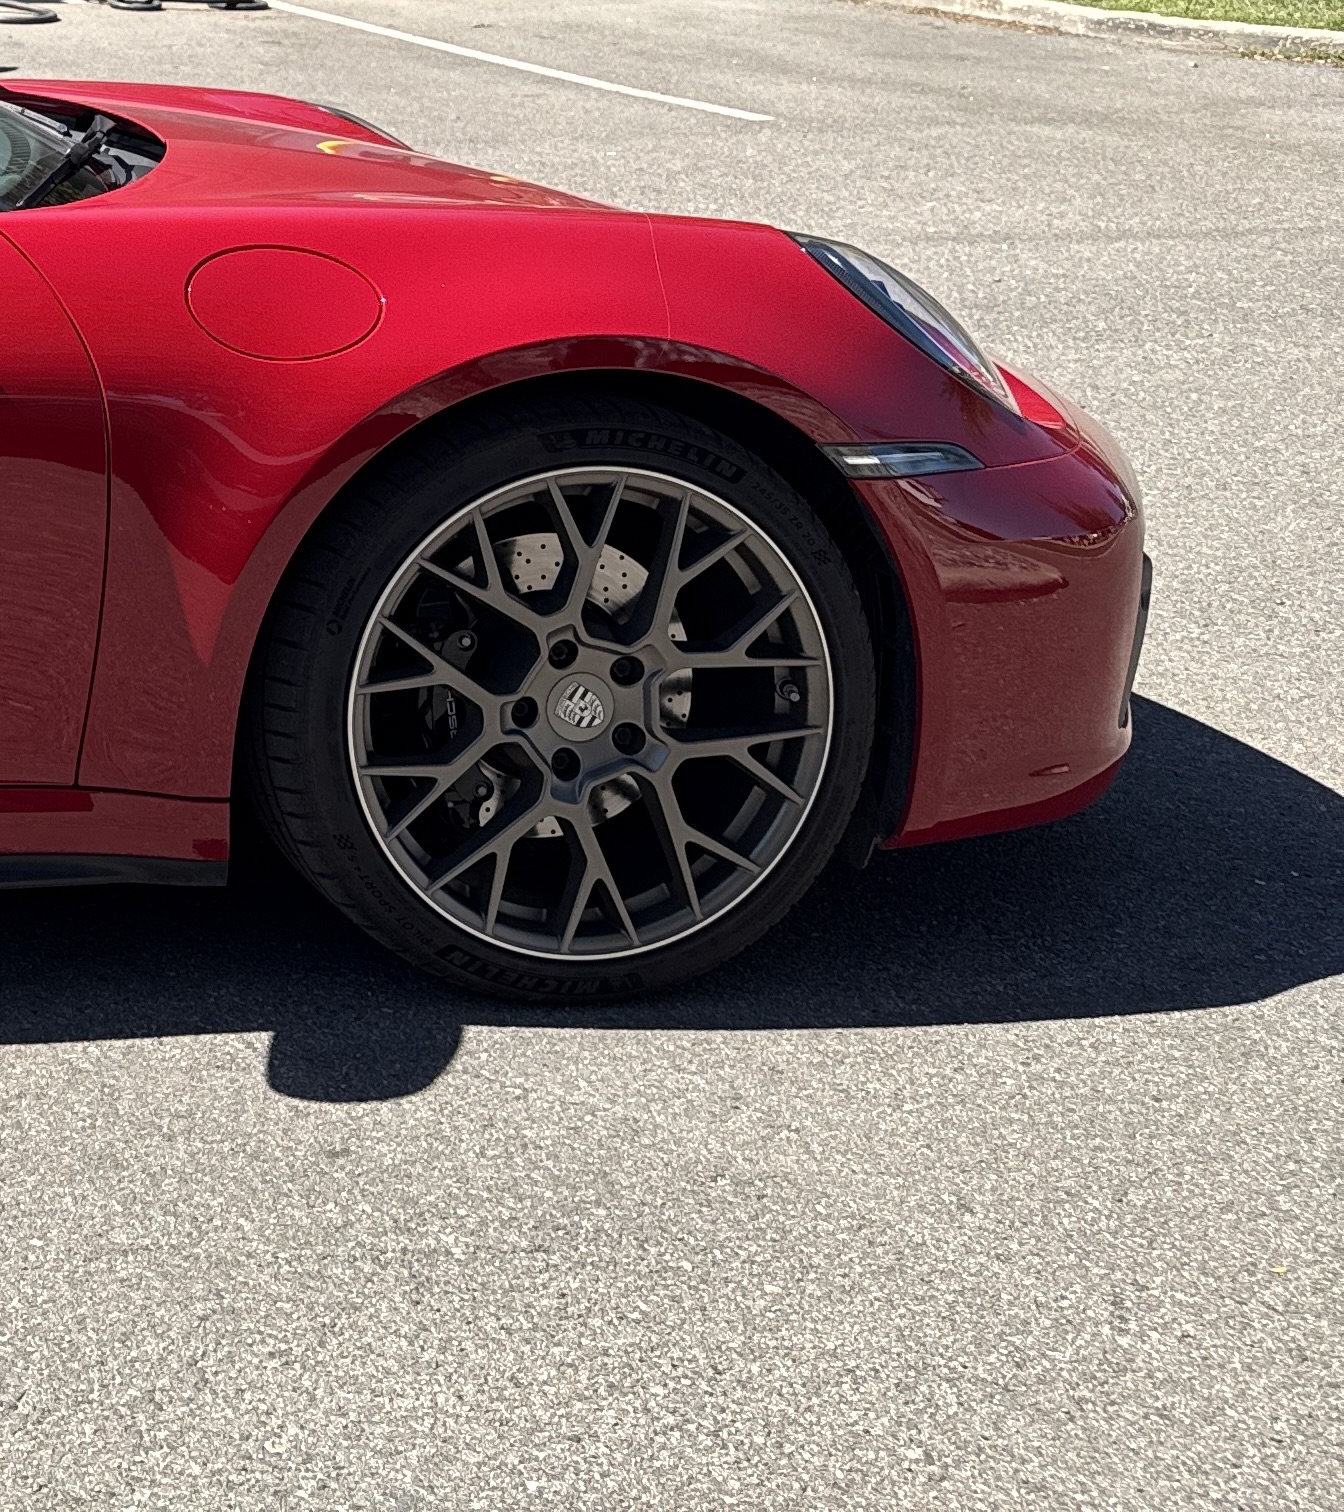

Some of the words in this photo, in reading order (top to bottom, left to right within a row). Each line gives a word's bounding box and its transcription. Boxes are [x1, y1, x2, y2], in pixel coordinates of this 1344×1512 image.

[584, 428, 739, 480] MICHELIN
[358, 873, 396, 914] SPORT
[394, 916, 433, 946] PILOT
[442, 948, 601, 996] MICHELIN
